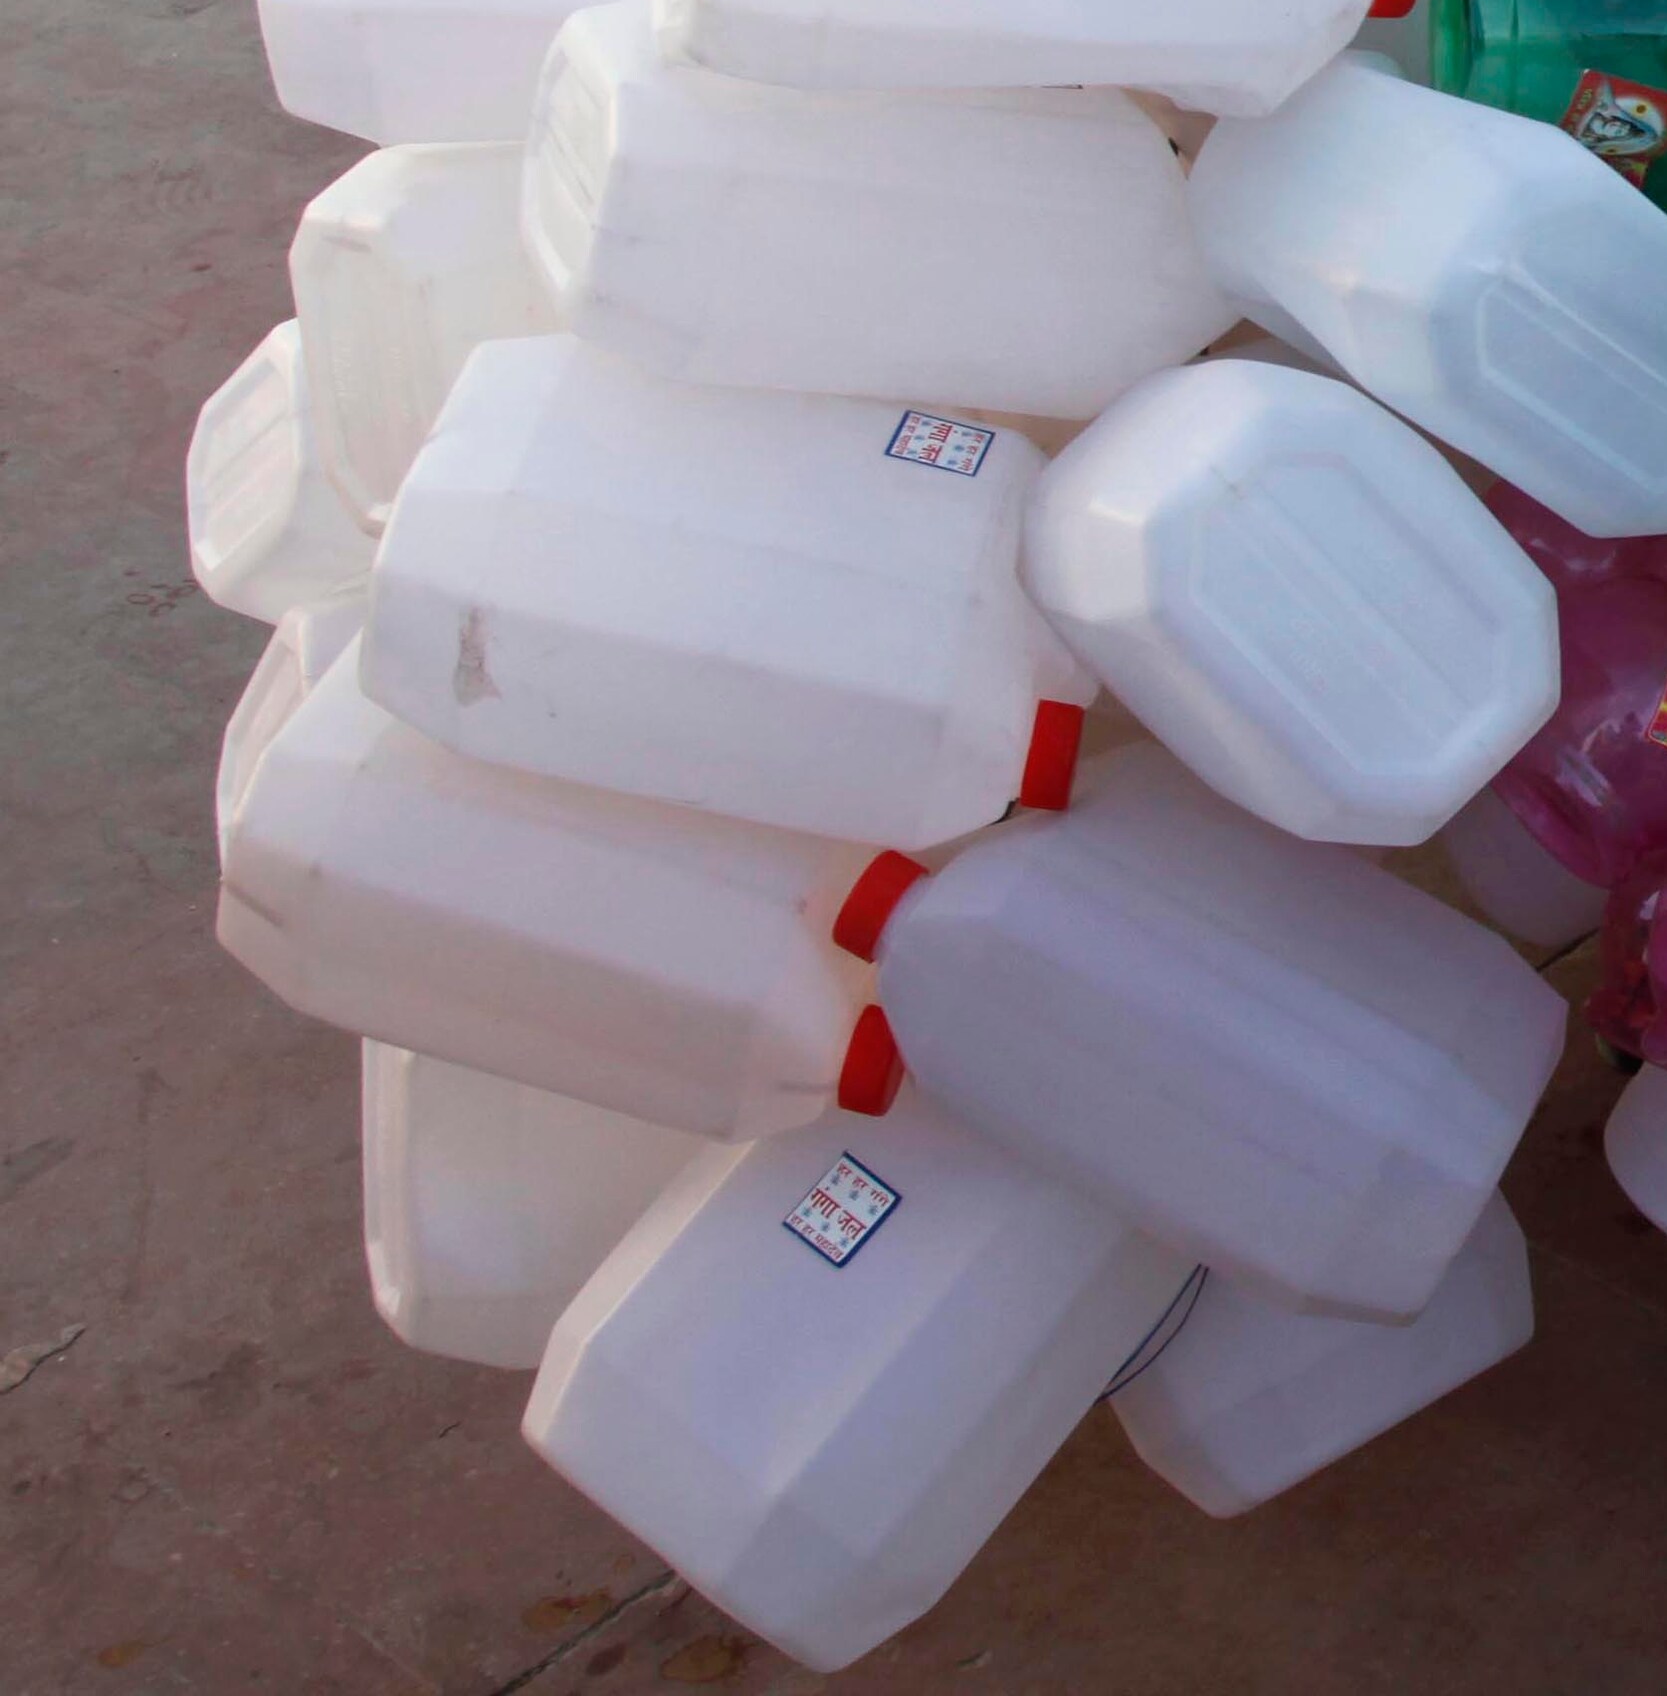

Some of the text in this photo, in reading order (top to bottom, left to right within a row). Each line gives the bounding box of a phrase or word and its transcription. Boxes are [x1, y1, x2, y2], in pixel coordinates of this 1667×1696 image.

[918, 423, 958, 463] गंगा जल
[810, 1186, 867, 1240] गंगा जल
[870, 1188, 890, 1207] गंगे
